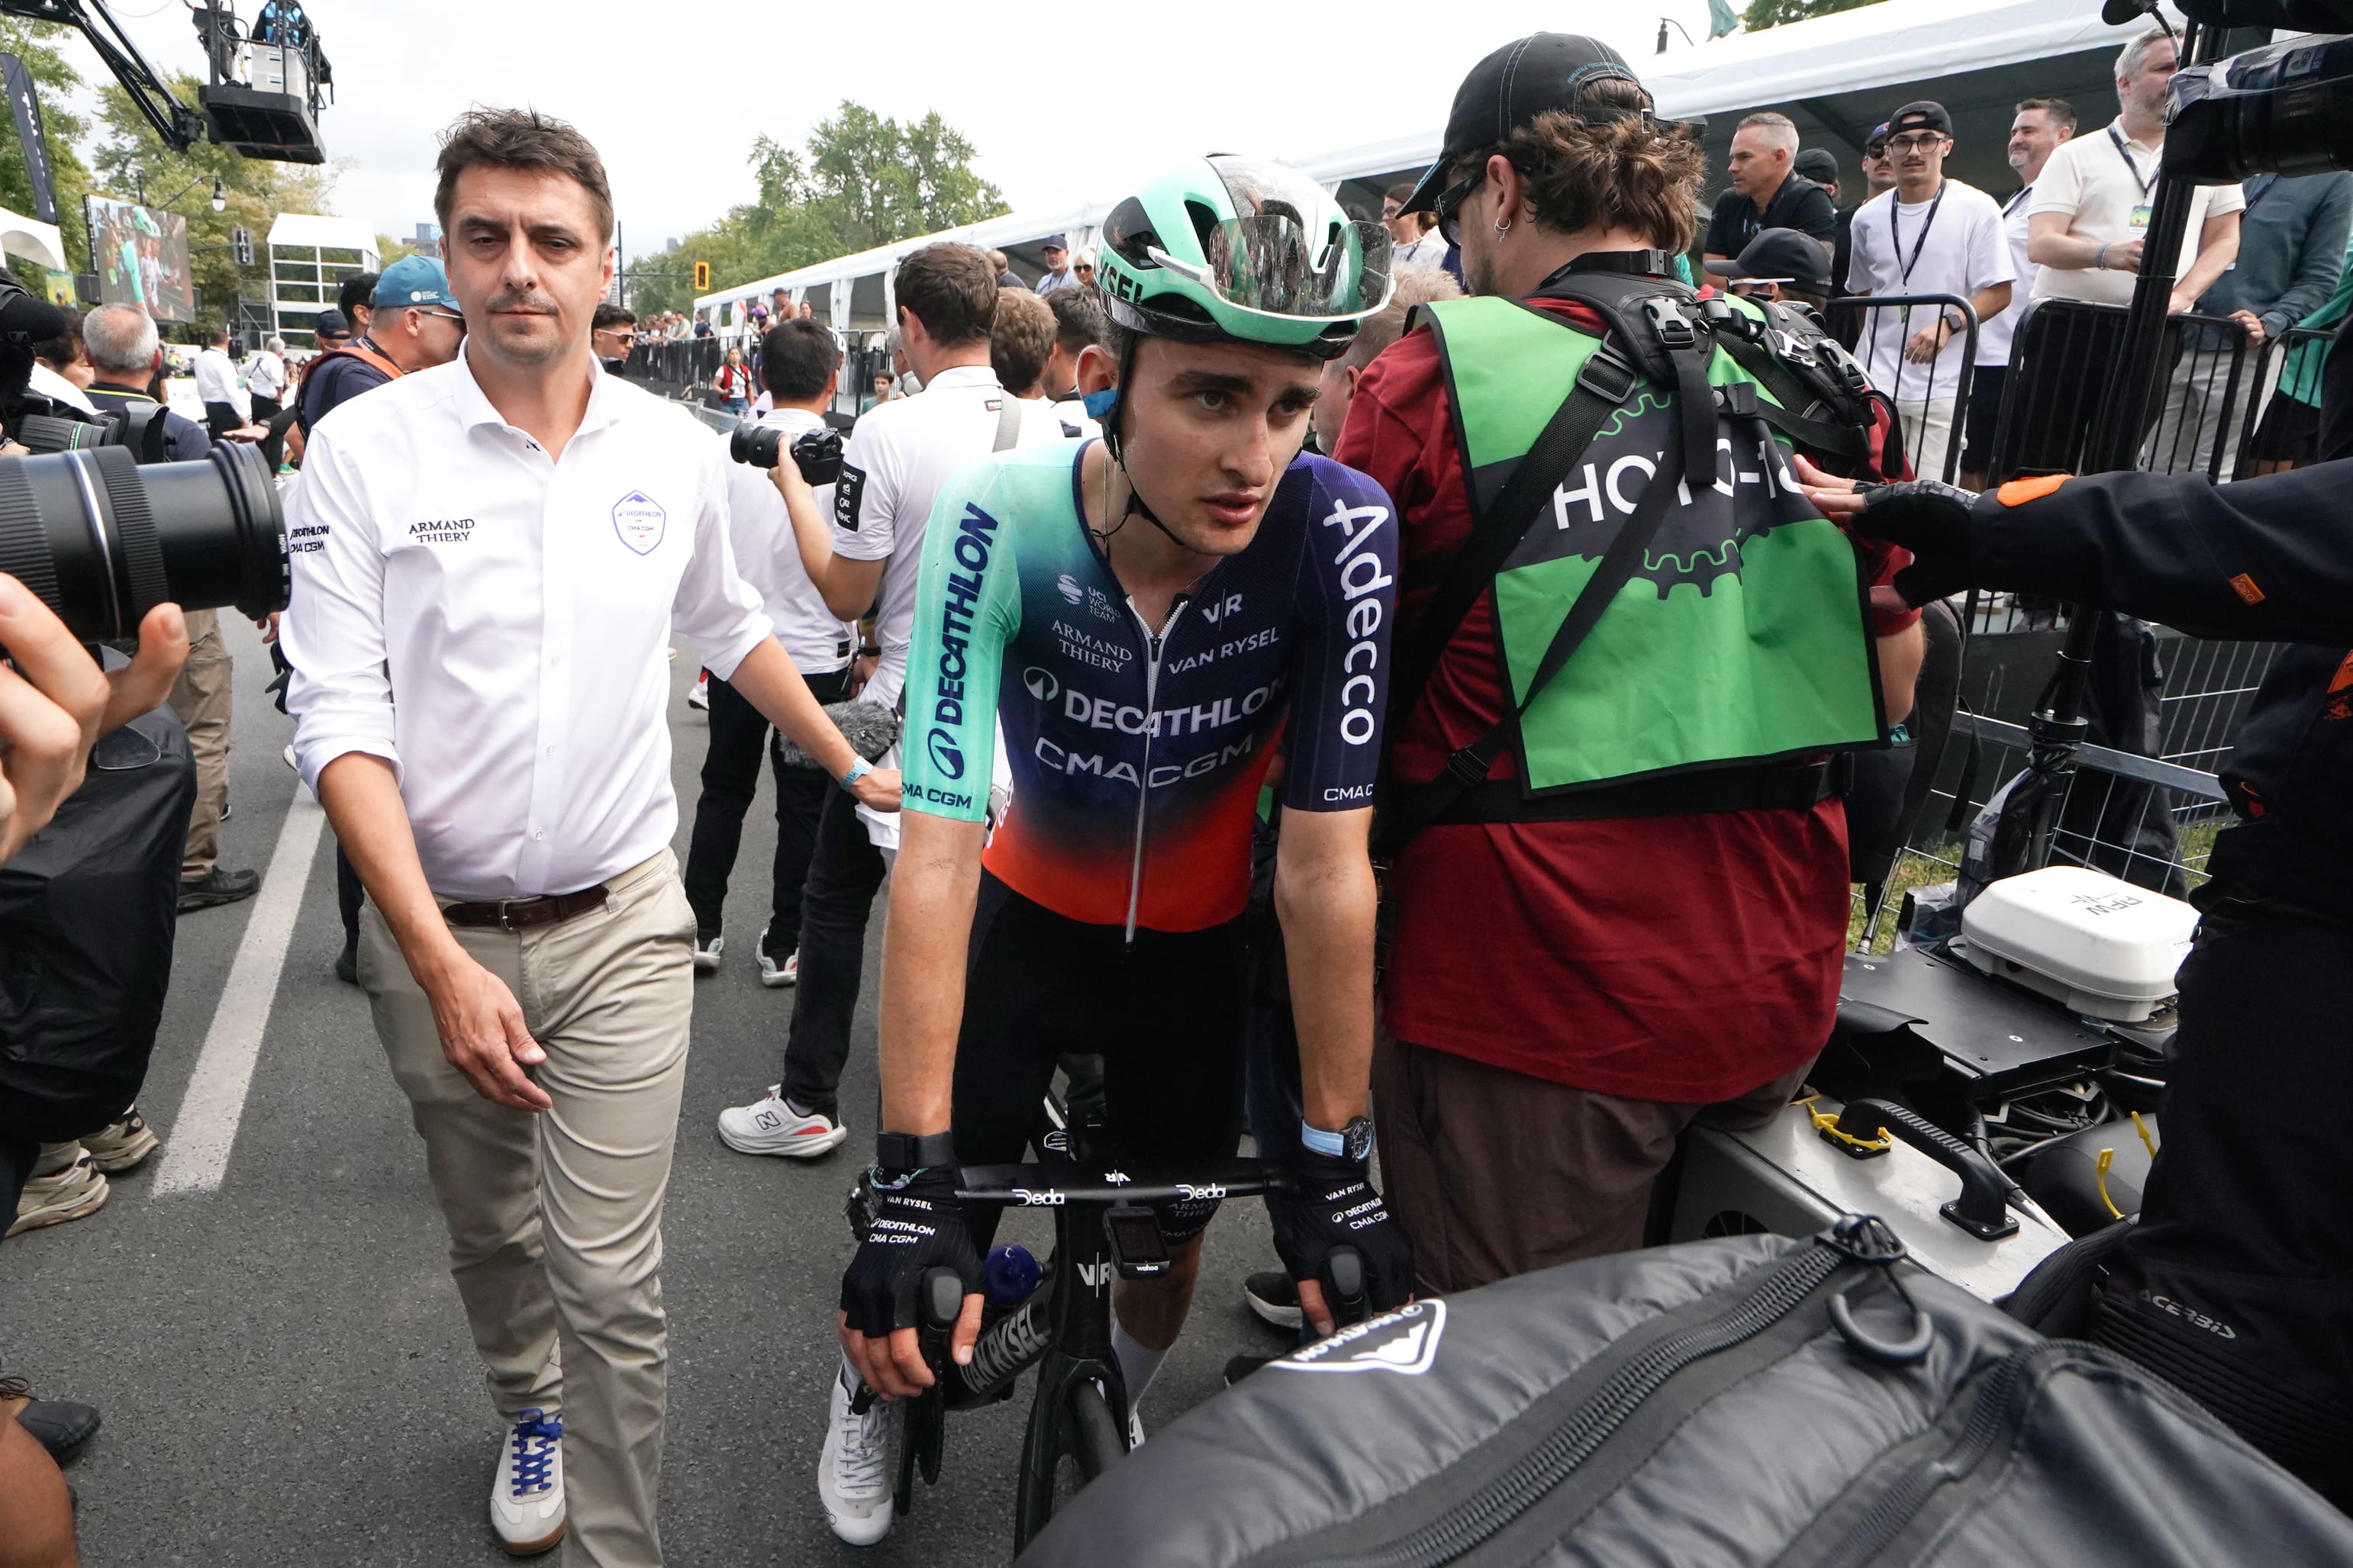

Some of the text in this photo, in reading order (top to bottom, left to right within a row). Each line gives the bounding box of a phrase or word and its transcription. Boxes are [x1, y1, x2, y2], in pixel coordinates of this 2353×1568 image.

[409, 519, 475, 534] ARMAND
[417, 531, 470, 543] THIERY
[1088, 586, 1107, 603] UCI
[935, 501, 998, 726] DECATHLON
[1089, 595, 1121, 618] WORLD
[1089, 605, 1115, 623] TEAM
[1323, 498, 1392, 745] Adecco
[1052, 619, 1133, 662] ARMAND
[1059, 639, 1123, 674] THIERY
[1168, 626, 1279, 675] VAN RYSEL
[1035, 732, 1254, 788] CMA CGM
[927, 788, 972, 809] CGM
[1324, 785, 1364, 801] CMA
[1012, 1188, 1065, 1206] Deda
[1175, 1183, 1226, 1201] Deda
[1325, 1188, 1346, 1201] VAN
[887, 1196, 933, 1210] VAN RYSEL
[878, 1219, 936, 1235] DECATHLON
[1349, 1216, 1376, 1229] CMA
[869, 1233, 918, 1244] CMA CGM
[988, 1302, 1052, 1373] RYSEL
